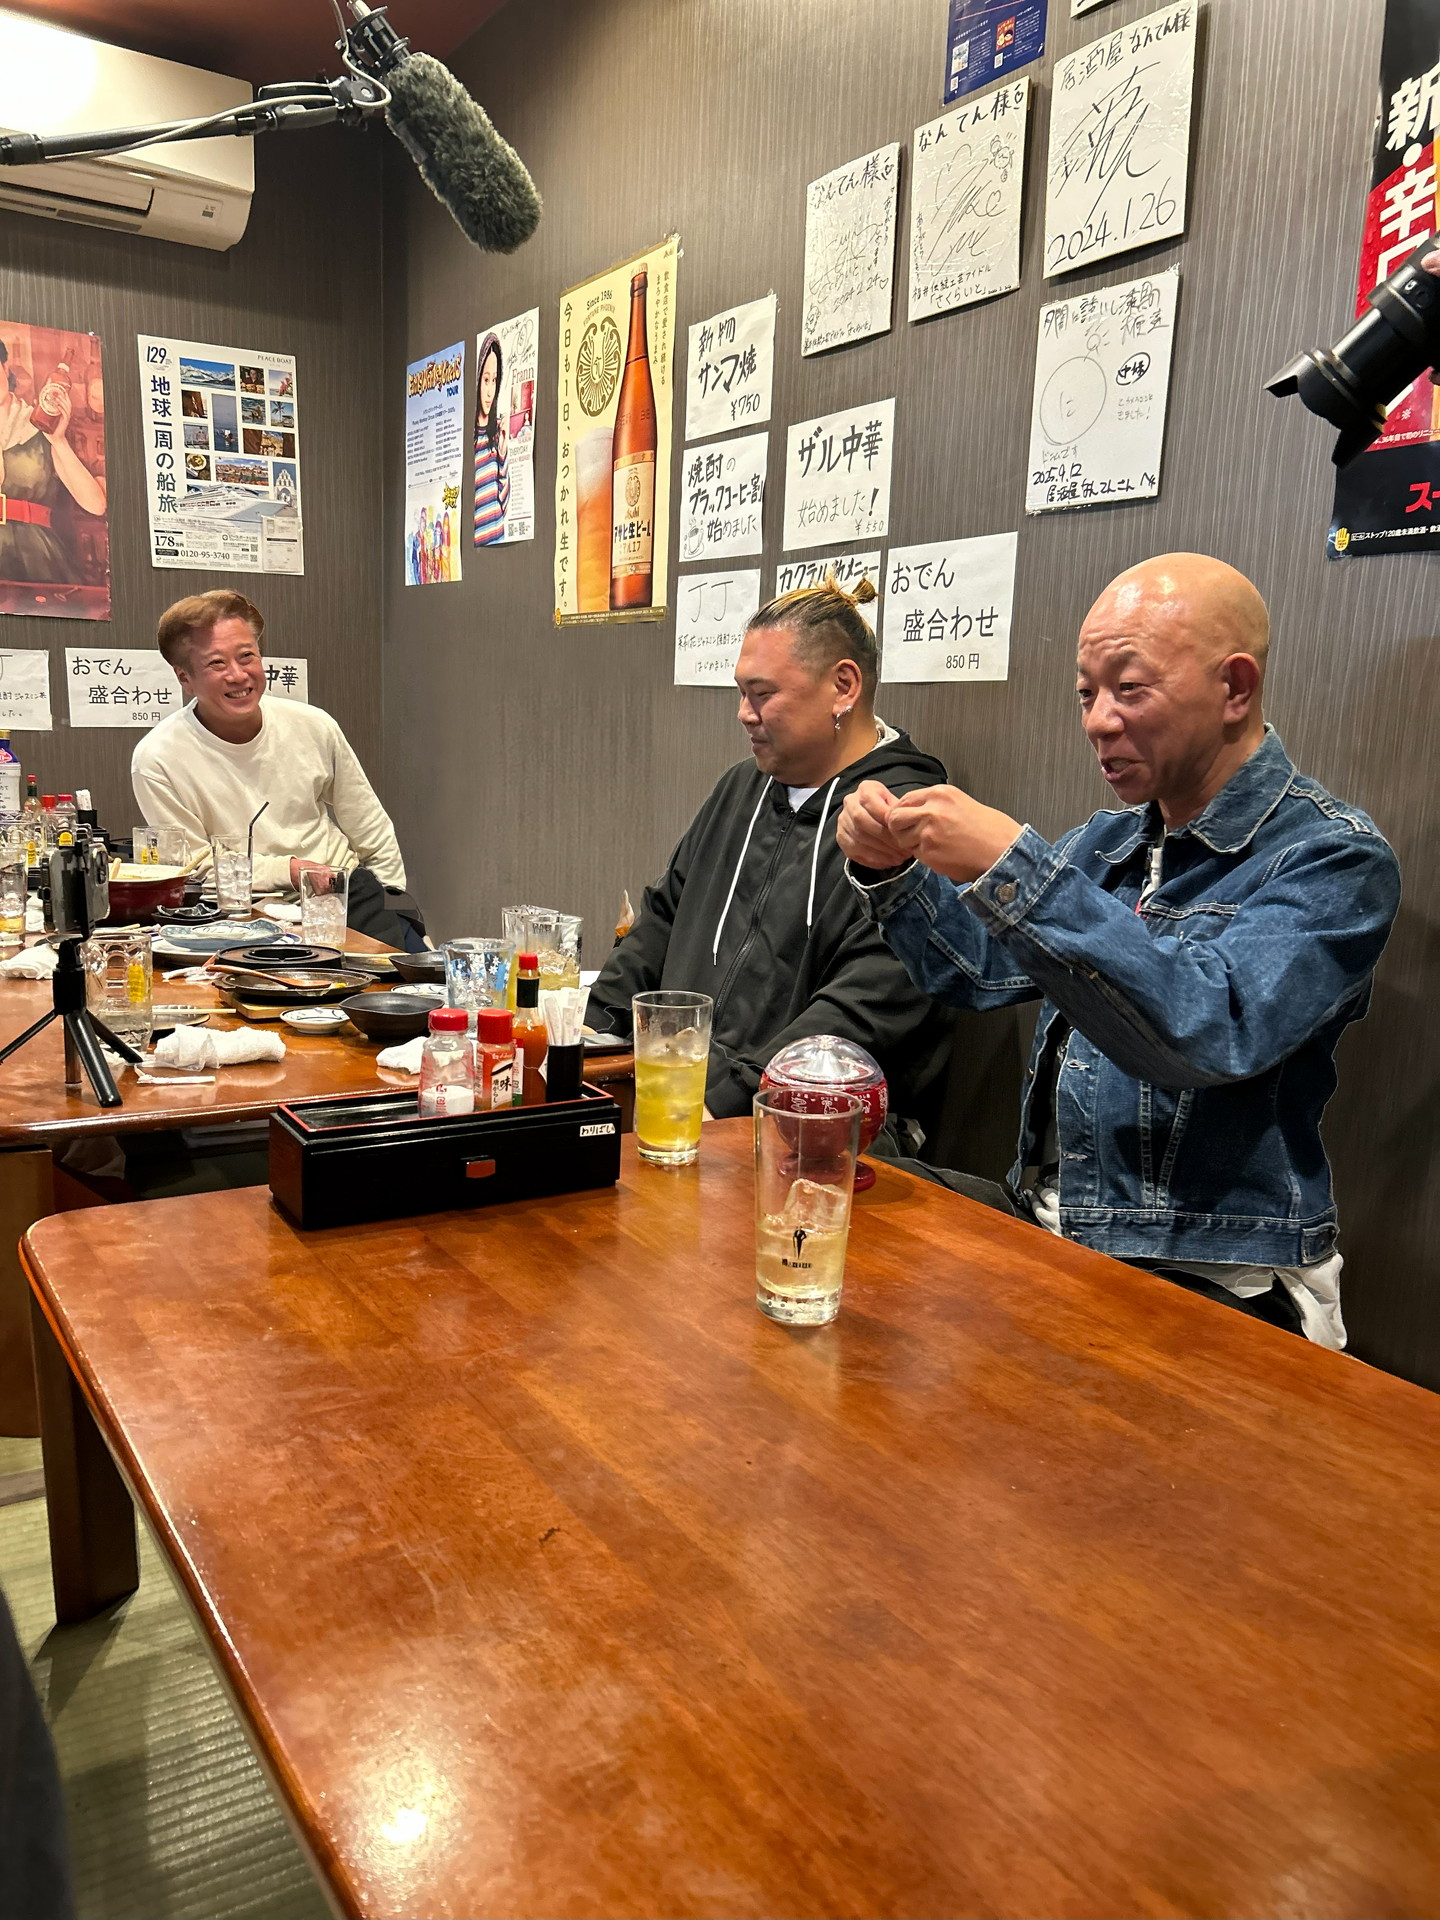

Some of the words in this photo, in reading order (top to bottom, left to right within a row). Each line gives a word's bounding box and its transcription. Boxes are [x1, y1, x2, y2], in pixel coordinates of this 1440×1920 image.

[1047, 177, 1176, 271] 2024.1.26
[146, 345, 167, 364] 129
[698, 344, 757, 399] サンマ焼
[151, 375, 178, 513] 地球一周の船旅
[798, 420, 883, 478] ザル中華
[614, 519, 651, 543] アサヒ生ビール
[180, 550, 230, 560] 0120-95-3740
[891, 558, 955, 595] おでん
[903, 605, 999, 642] 盛合わせ
[72, 656, 132, 676] おでん
[88, 685, 172, 705] 盛合わせ
